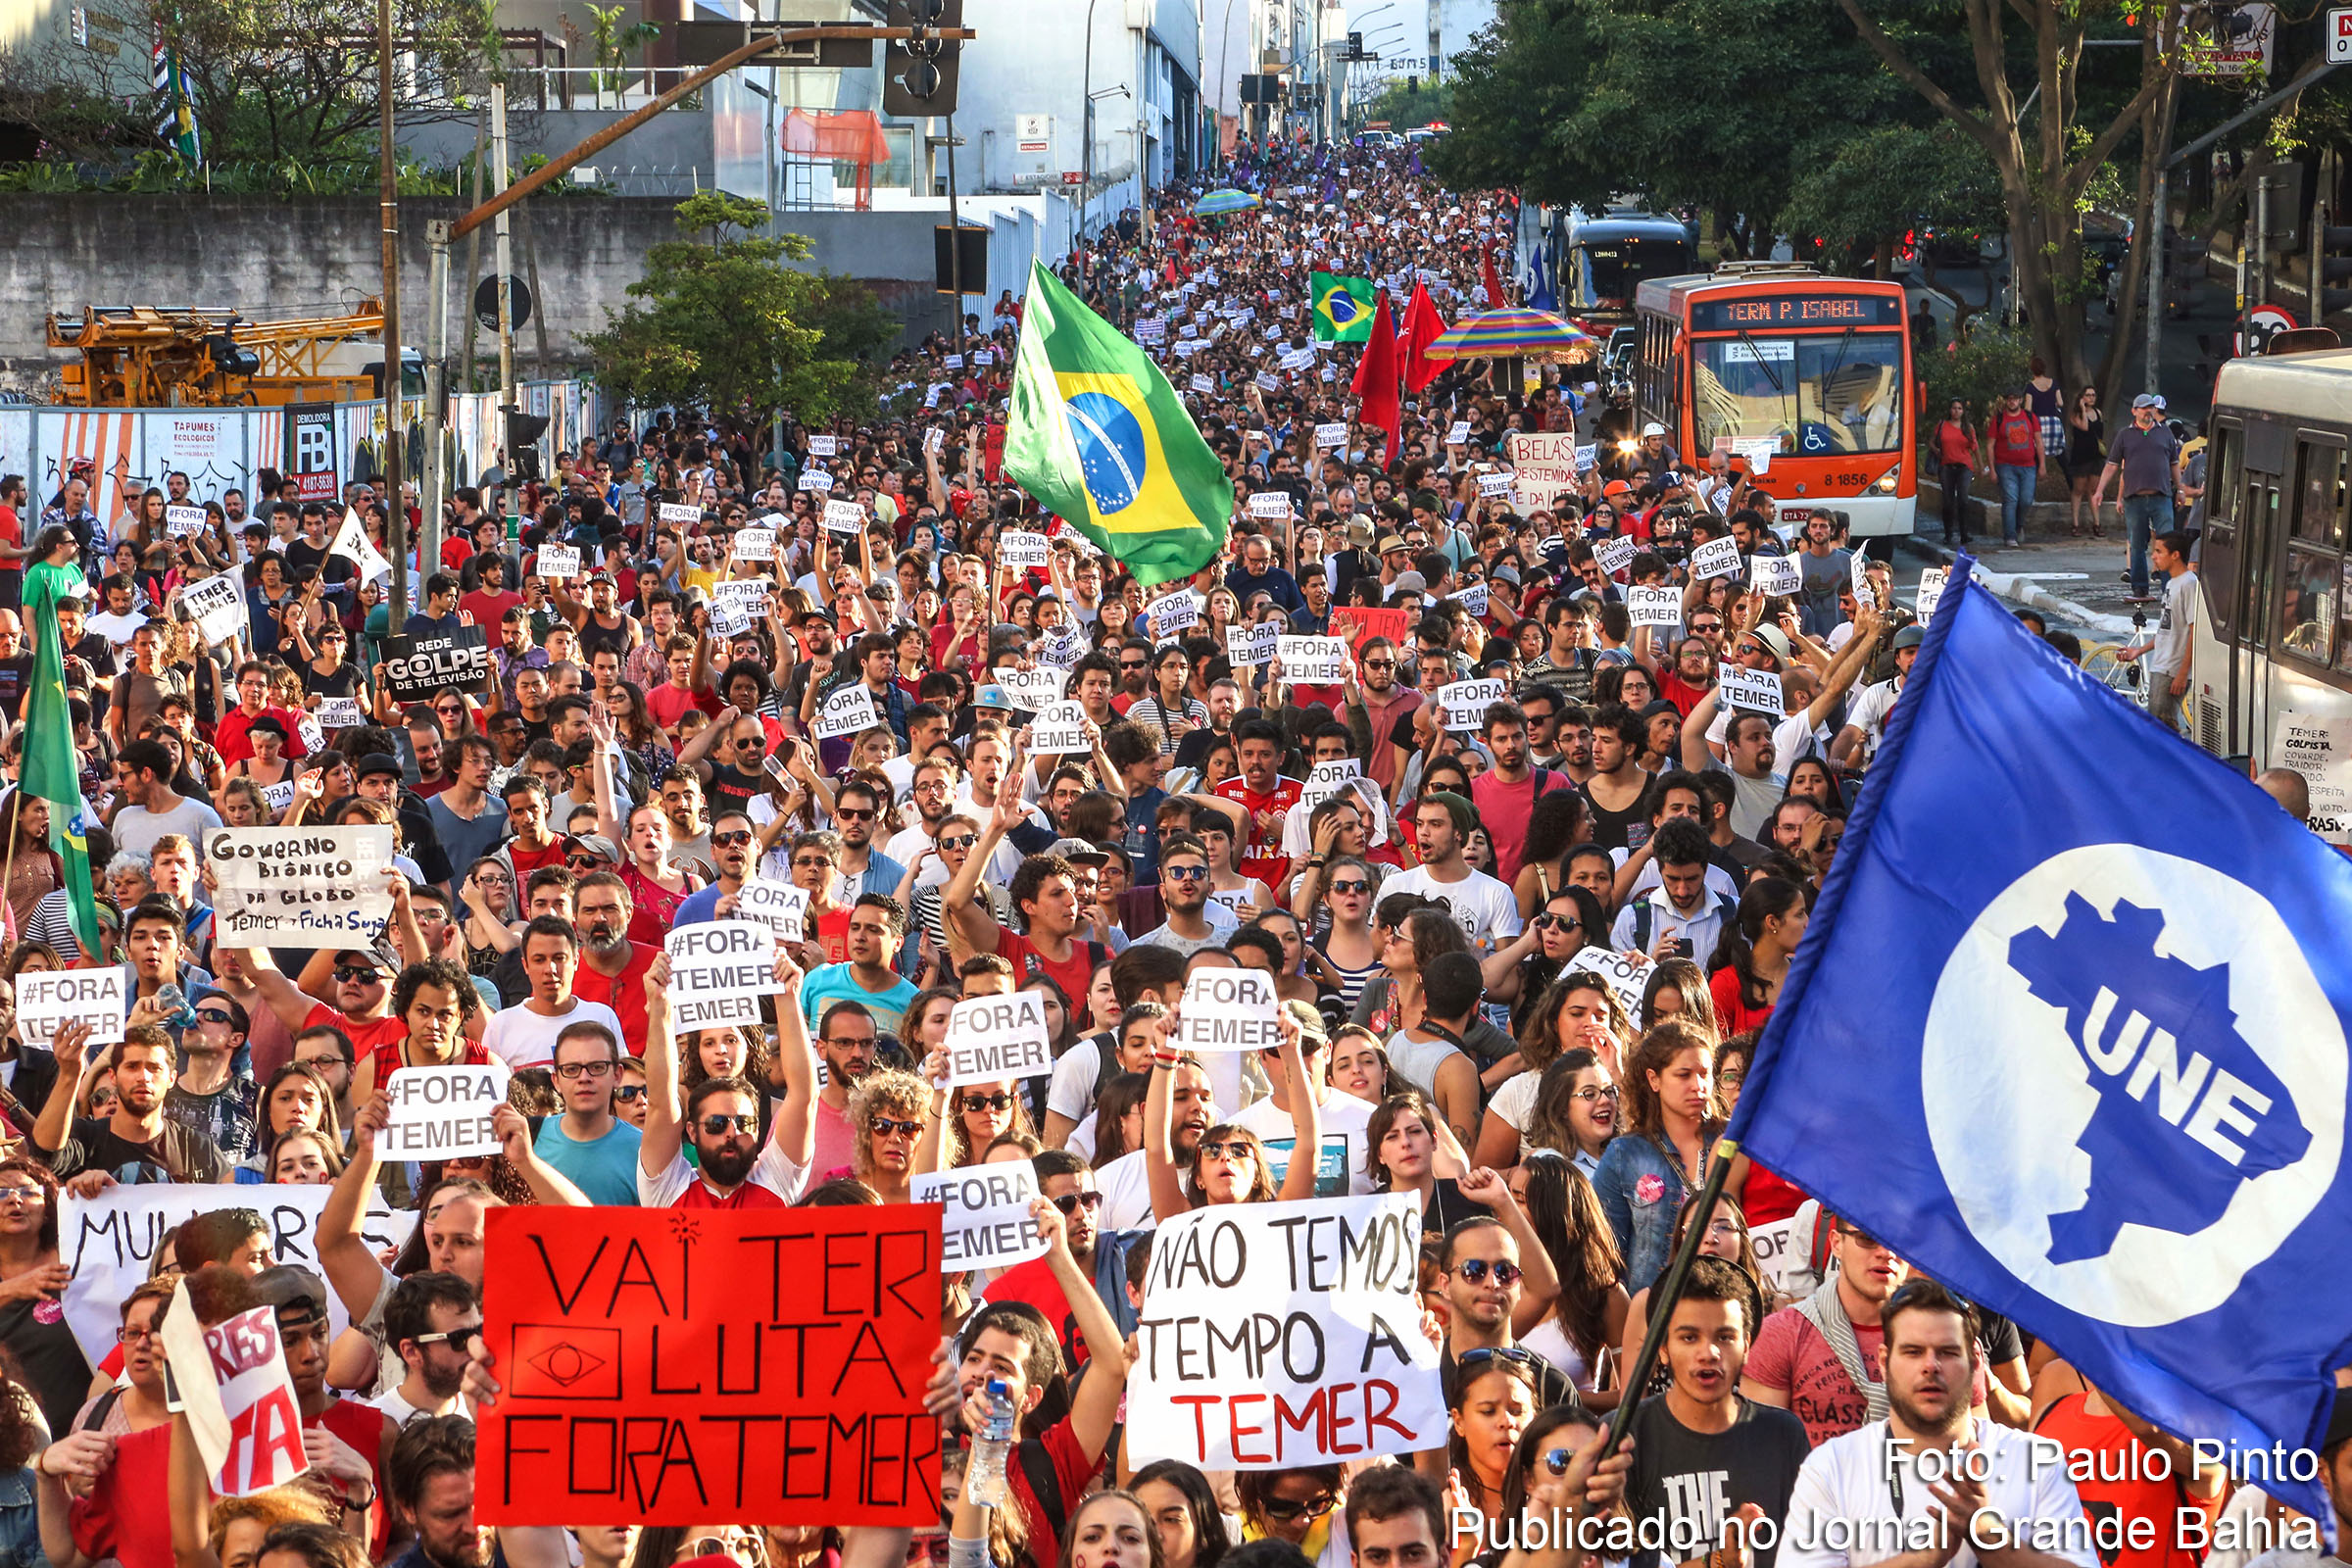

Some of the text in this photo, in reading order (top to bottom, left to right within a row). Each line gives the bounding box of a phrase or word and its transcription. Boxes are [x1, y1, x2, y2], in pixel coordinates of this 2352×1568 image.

[1801, 300, 1866, 318] ISABEL
[174, 421, 215, 432] TAPUMES
[297, 413, 331, 423] DEMOLIDORA
[1317, 435, 1346, 444] TEMER
[1516, 436, 1575, 463] BELAS,
[1825, 473, 1871, 486] 8 1856
[1252, 493, 1289, 504] #FORA
[1530, 492, 1544, 506] DA
[168, 509, 205, 523] #FORA
[662, 507, 699, 521] #FORA
[1250, 506, 1287, 516] TEMER
[1004, 536, 1046, 547] #FORA
[1693, 540, 1735, 561] #FORA
[540, 548, 578, 560] #FORA
[1003, 551, 1046, 564] TEMER
[1600, 549, 1638, 570] TEMER
[539, 562, 577, 573] TEMER
[1697, 555, 1739, 576] TEMER
[1152, 595, 1193, 616] #FORA
[1631, 591, 1679, 604] #FORA
[709, 614, 748, 634] TEMER
[1160, 612, 1196, 631] EMER
[1631, 609, 1678, 621] TEMER
[1229, 626, 1276, 643] #FORA
[416, 637, 453, 653] REDE
[1230, 644, 1277, 662] TEMER
[1282, 642, 1343, 656] #FORA
[386, 645, 490, 680] GOLPE
[1039, 647, 1083, 665] TEMER
[395, 668, 486, 690] DE TELEVISÃO
[1001, 672, 1055, 687] #FORA
[1282, 663, 1342, 678] TEMER
[1724, 668, 1779, 690] #FORA
[1444, 684, 1502, 702] #FORA
[1722, 685, 1781, 710] TEMER
[318, 714, 358, 726] TEMER
[814, 710, 871, 735] TEMER
[1446, 709, 1484, 725] TEM
[1302, 791, 1333, 808] TEM
[1243, 845, 1288, 859] AIXA
[671, 929, 766, 956] #FORA
[672, 964, 778, 991] TEMER
[23, 977, 120, 1004] #FORA
[673, 997, 757, 1024] EMER
[22, 1011, 120, 1040] TEMER
[1177, 1018, 1283, 1044] TEMER
[2083, 988, 2274, 1167] UNE
[387, 1073, 499, 1106] #FORA
[385, 1114, 498, 1151] TEMER
[943, 1220, 1045, 1262] EMER
[1148, 1207, 1419, 1298] NÃO TEMOS
[527, 1212, 927, 1322] VAI TER
[1140, 1311, 1413, 1384] TEMPO A
[651, 1320, 906, 1398] LUTA
[1170, 1379, 1418, 1464] TEMER
[1663, 1470, 1732, 1542] THE
